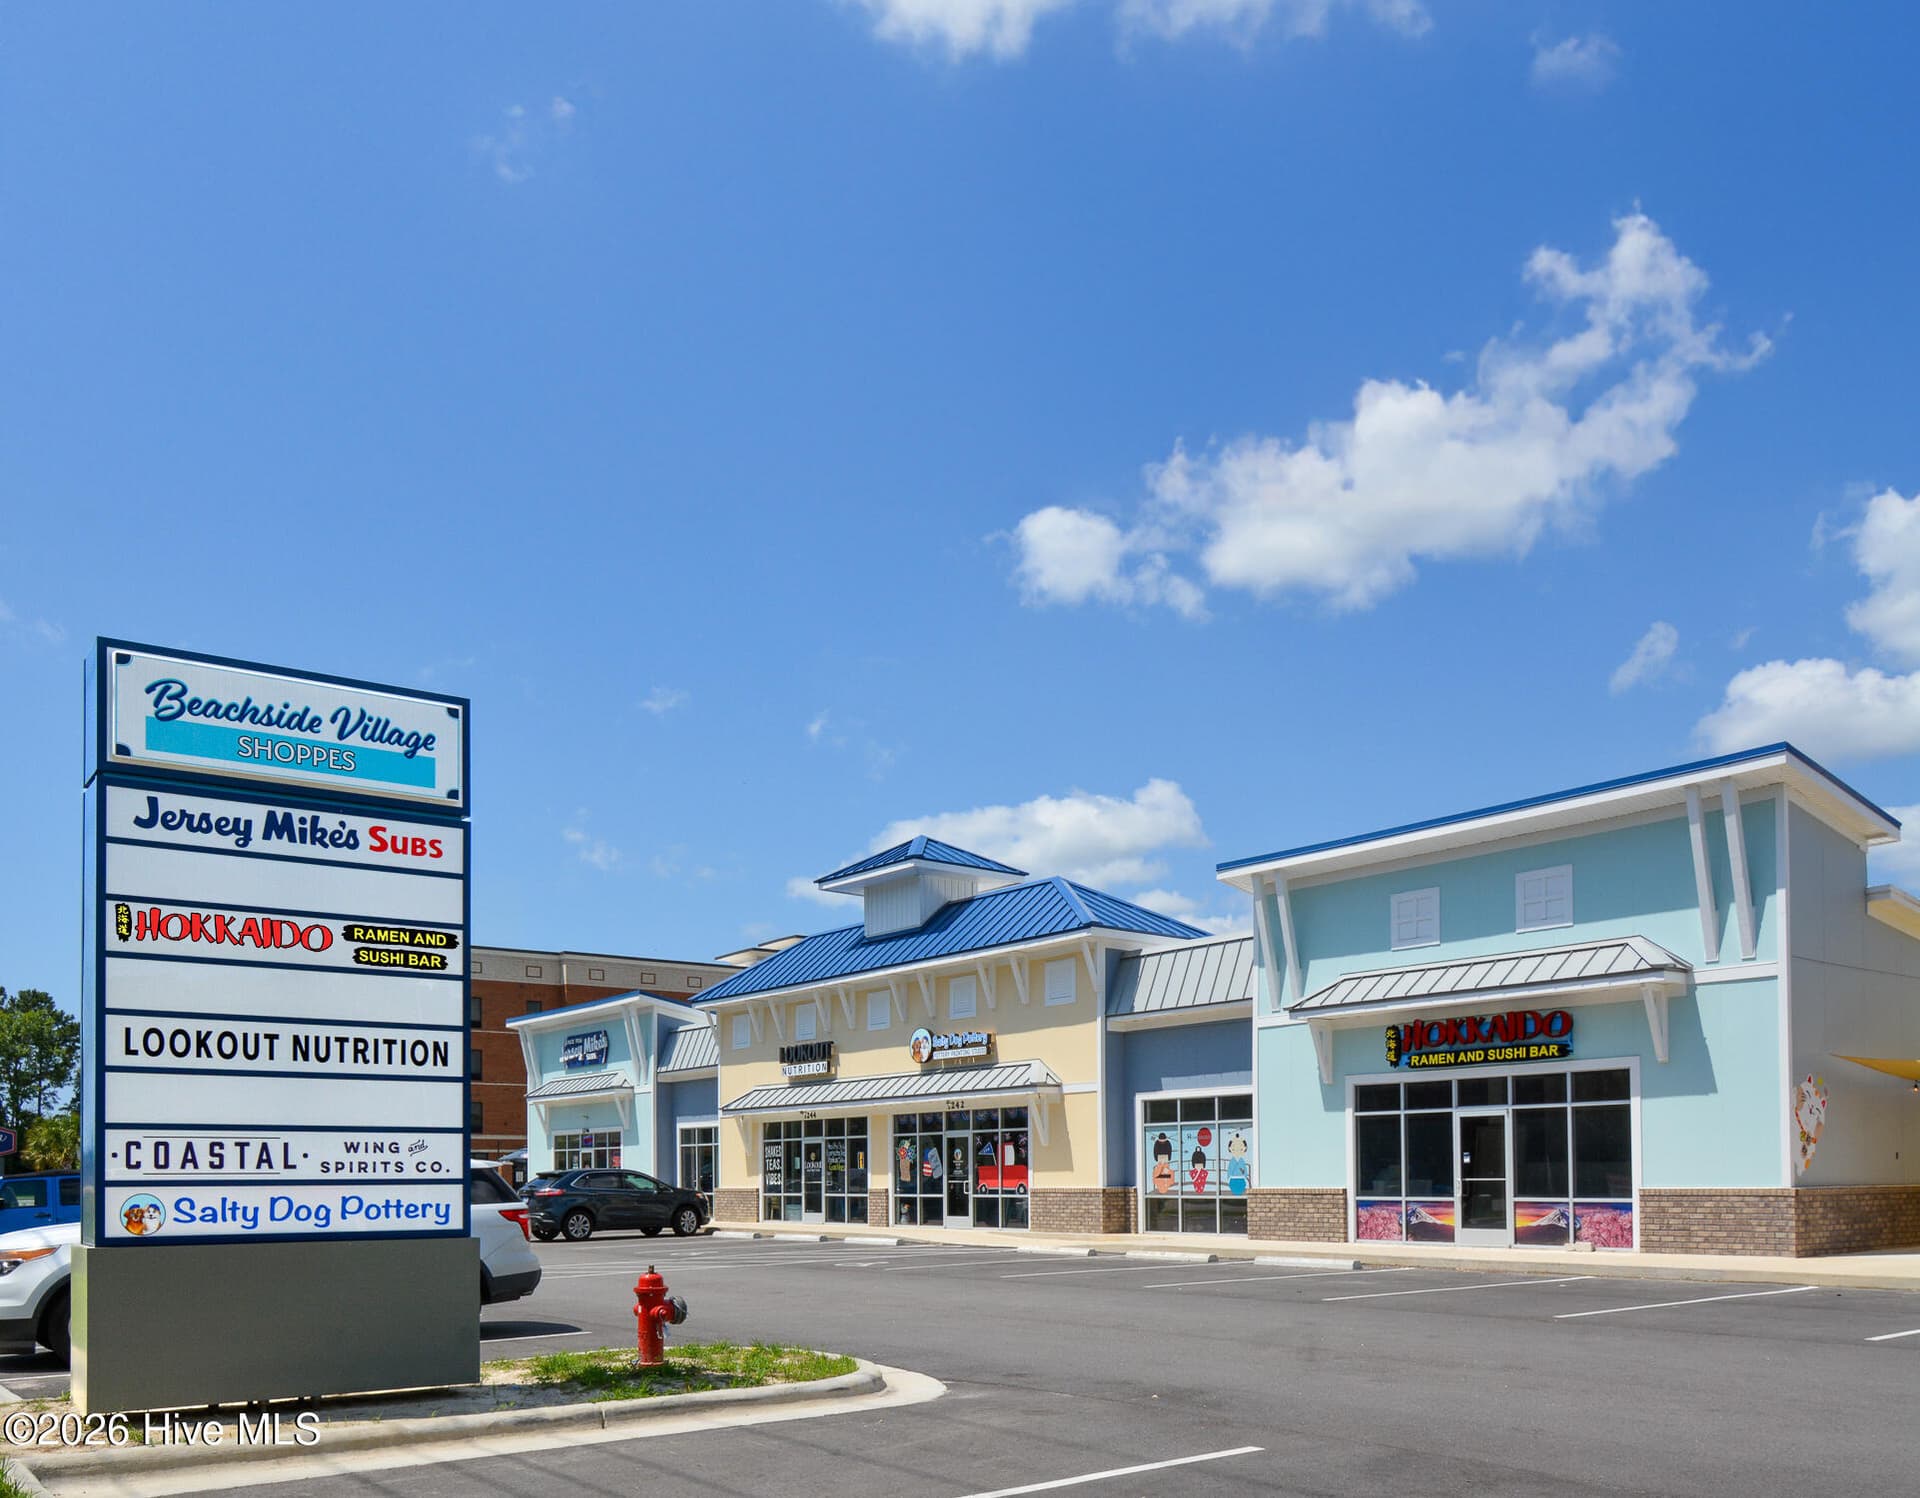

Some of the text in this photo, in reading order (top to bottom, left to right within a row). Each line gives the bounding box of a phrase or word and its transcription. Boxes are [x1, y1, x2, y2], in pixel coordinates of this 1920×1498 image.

[145, 677, 436, 759] Beachside Village
[237, 735, 357, 772] SHOPPES
[133, 796, 443, 859] Jersey Mike's SUBS
[116, 904, 130, 937] 北海道
[135, 907, 334, 952] HOKKAIDO
[353, 927, 448, 947] RAMEN AND
[358, 950, 442, 968] SUSHI BAR
[1401, 1010, 1574, 1053] HOKKAIDO
[124, 1027, 450, 1068] LOOKOUT NUTRITION
[779, 1040, 835, 1065] LOOKOUT
[1410, 1045, 1559, 1067] RAMEN AND SUSHI BAR
[782, 1062, 828, 1077] NUTRITION
[125, 1141, 297, 1171] COASTAL
[344, 1139, 428, 1157] WING and
[320, 1161, 451, 1174] SPIRITS CO.
[173, 1195, 451, 1230] Salty Dog Pottery
